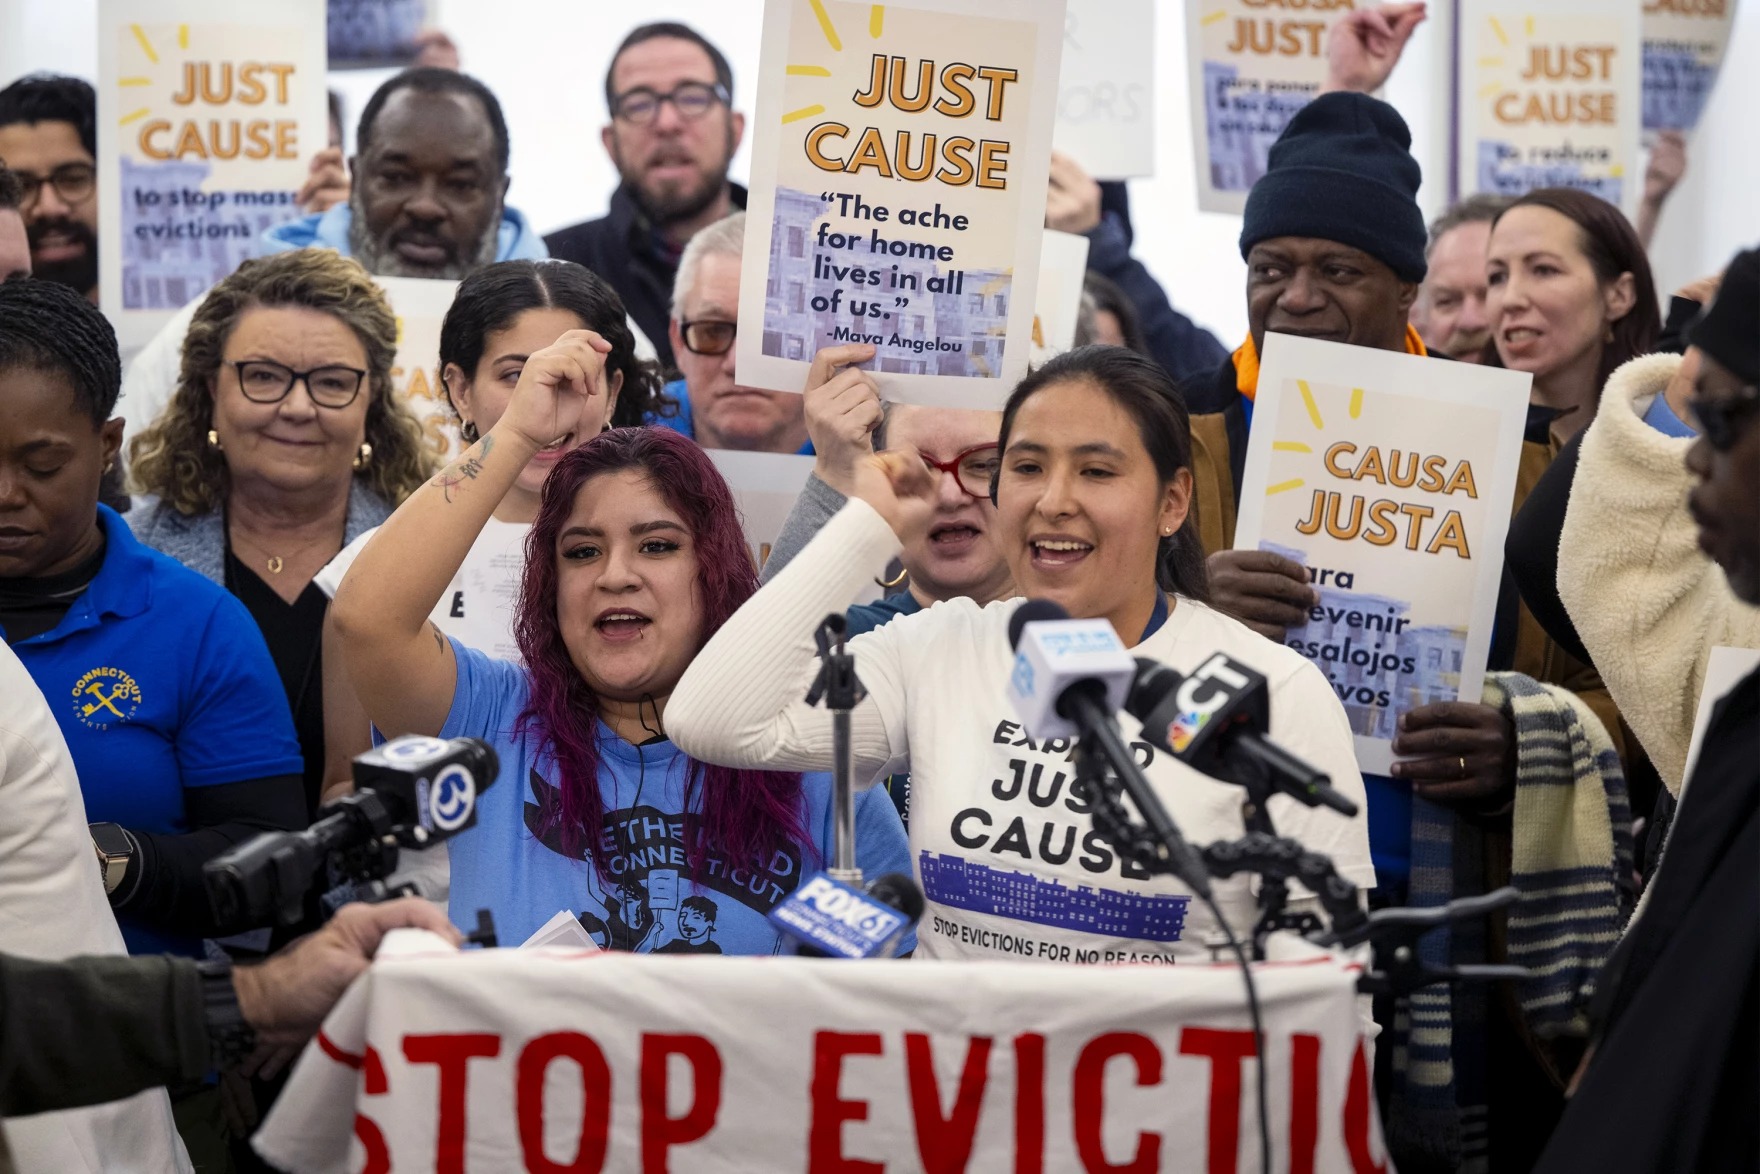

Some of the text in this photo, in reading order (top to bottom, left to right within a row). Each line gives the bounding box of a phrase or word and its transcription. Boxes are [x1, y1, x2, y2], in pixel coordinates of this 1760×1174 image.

[1227, 18, 1330, 57] JUST
[1521, 44, 1617, 81] JUST
[172, 62, 296, 106] JUST
[852, 53, 1019, 122] JUST
[1058, 80, 1146, 124] ORS
[1493, 92, 1618, 126] CAUSE
[138, 119, 299, 161] CAUSE
[803, 121, 1011, 190] CAUSE
[134, 186, 161, 206] to
[168, 187, 226, 211] stop
[820, 191, 969, 231] “The ache
[134, 216, 252, 239] evictions
[817, 222, 954, 261] for home
[814, 254, 964, 295] lives in all
[811, 288, 909, 320] of us.”
[888, 332, 962, 353] Angelou
[1324, 441, 1478, 499] CAUSA
[1295, 489, 1471, 559] JUSTA
[1305, 566, 1354, 589] ara
[1309, 605, 1411, 635] evenir
[1287, 637, 1415, 676] esalojos
[72, 667, 142, 704] CONNECTICUT
[1176, 655, 1249, 714] CT
[1330, 673, 1390, 708] ivos
[73, 700, 107, 730] TENANTS
[993, 719, 1154, 772] EXPD
[991, 758, 1127, 814] JUS
[620, 817, 685, 845] THE
[604, 845, 785, 904] ONNETICUT
[934, 916, 1176, 966] STOP EVICTIONS FOR NO REASON
